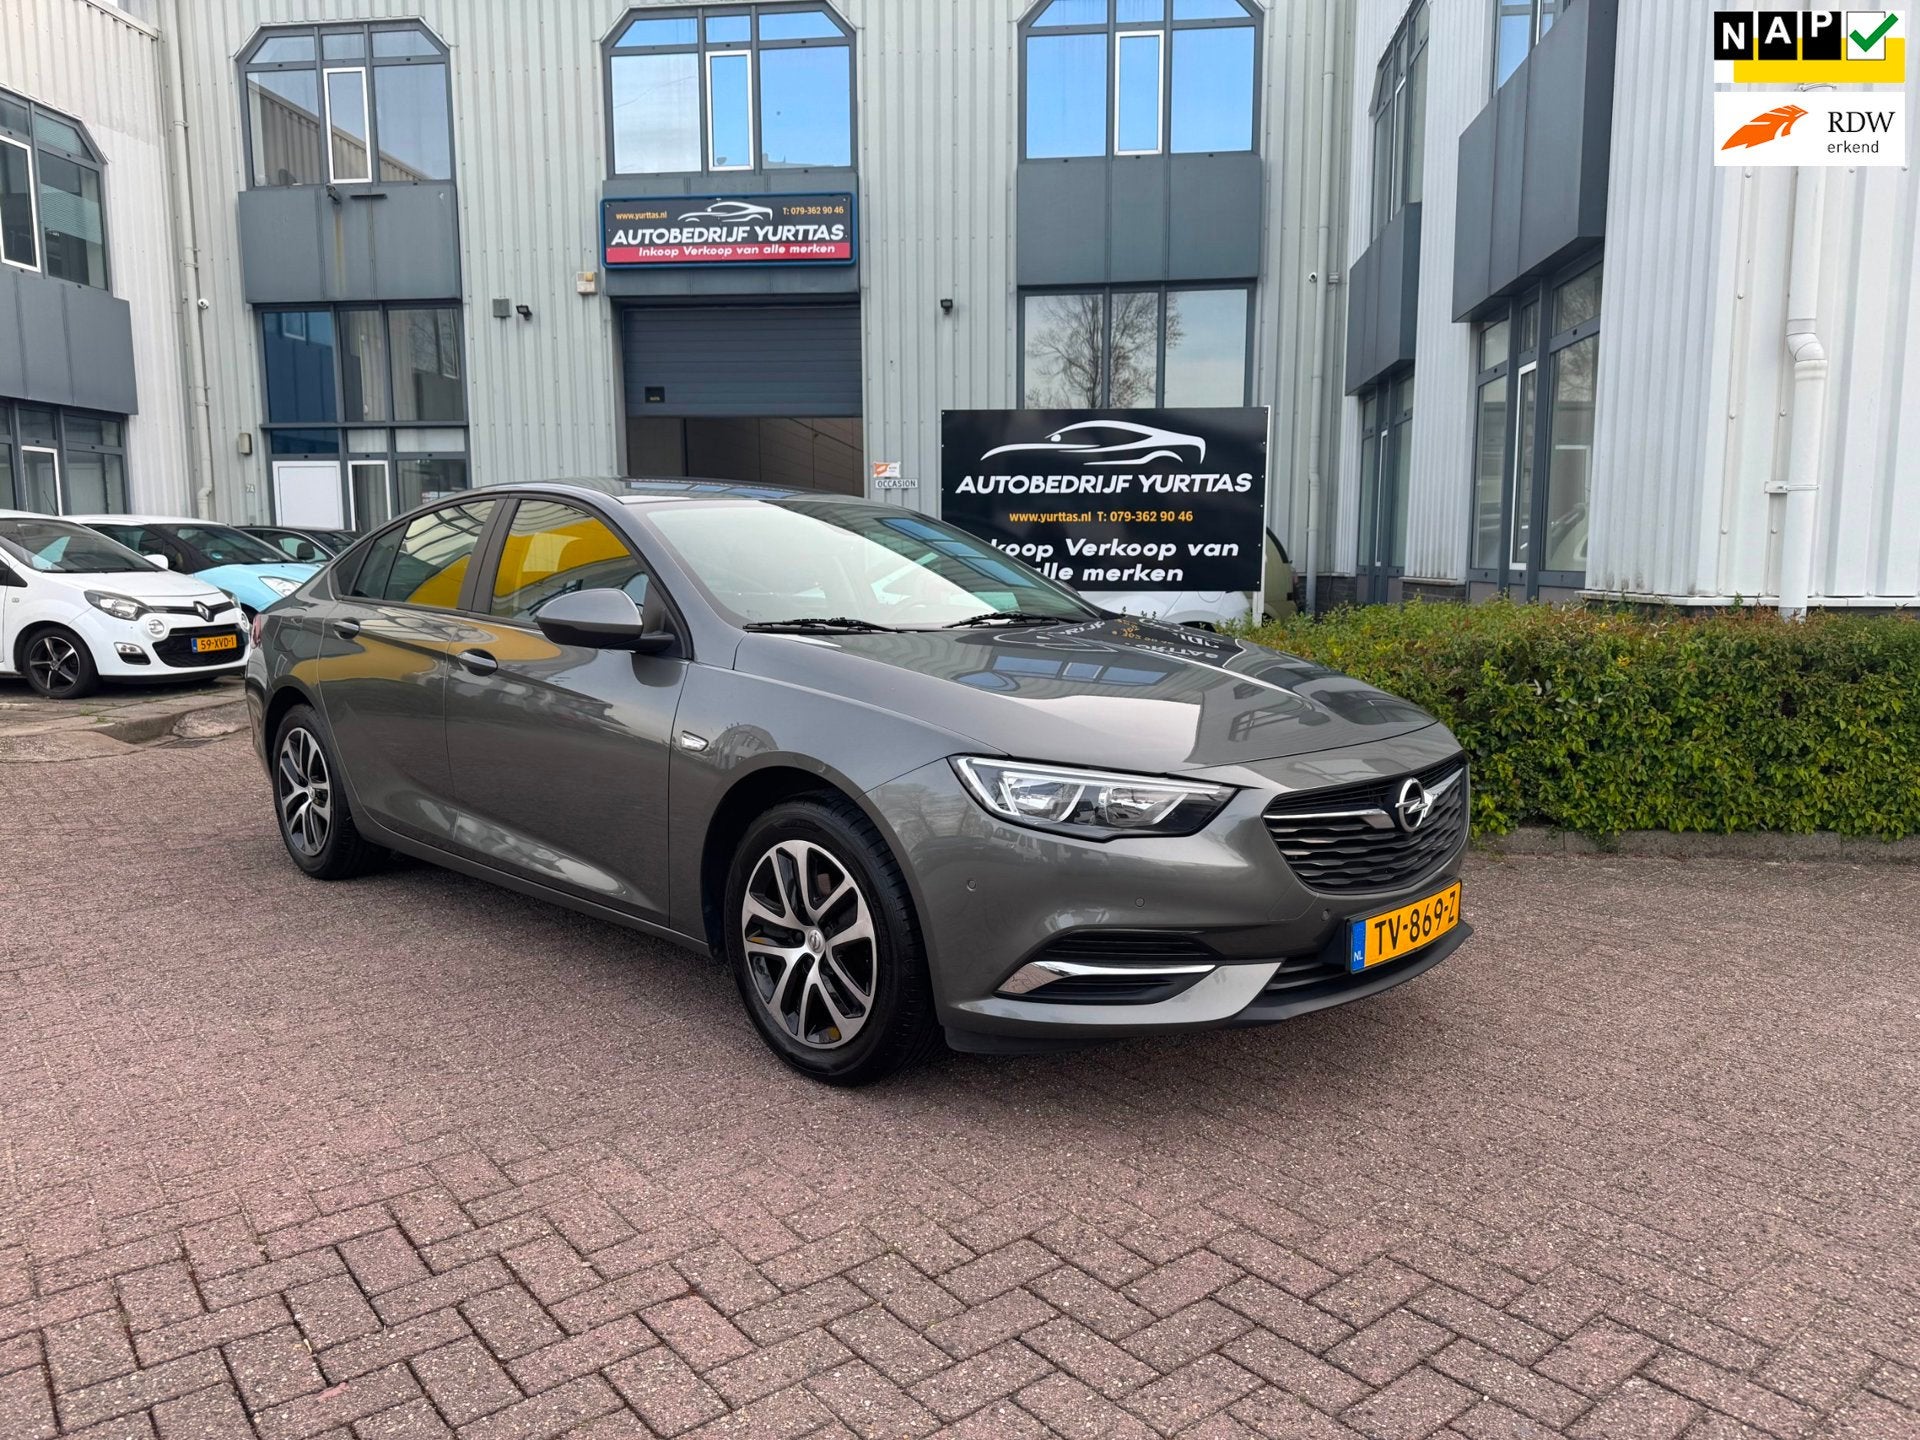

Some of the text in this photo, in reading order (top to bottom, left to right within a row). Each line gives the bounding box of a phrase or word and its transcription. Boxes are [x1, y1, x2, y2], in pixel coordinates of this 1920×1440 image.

[616, 211, 667, 220] www.yurttas.nl
[783, 205, 844, 215] T: 079-362 90 46
[611, 224, 844, 246] AUTOBEDRIJF YURTTAS
[639, 243, 835, 258] Inkoop Verkoop van alle merken
[877, 480, 916, 488] OCCASION
[955, 473, 1253, 494] AUTOBEDRIJF YURTTAS
[1009, 511, 1193, 522] www.yurttas.nl T: 079-362 90 46
[1065, 538, 1177, 561] Verkoop
[1187, 543, 1239, 556] van
[1034, 562, 1184, 581] lle merken
[200, 636, 234, 650] 59-XVD-1
[1374, 891, 1456, 955] TV-869-Z
[1353, 951, 1364, 962] NL
